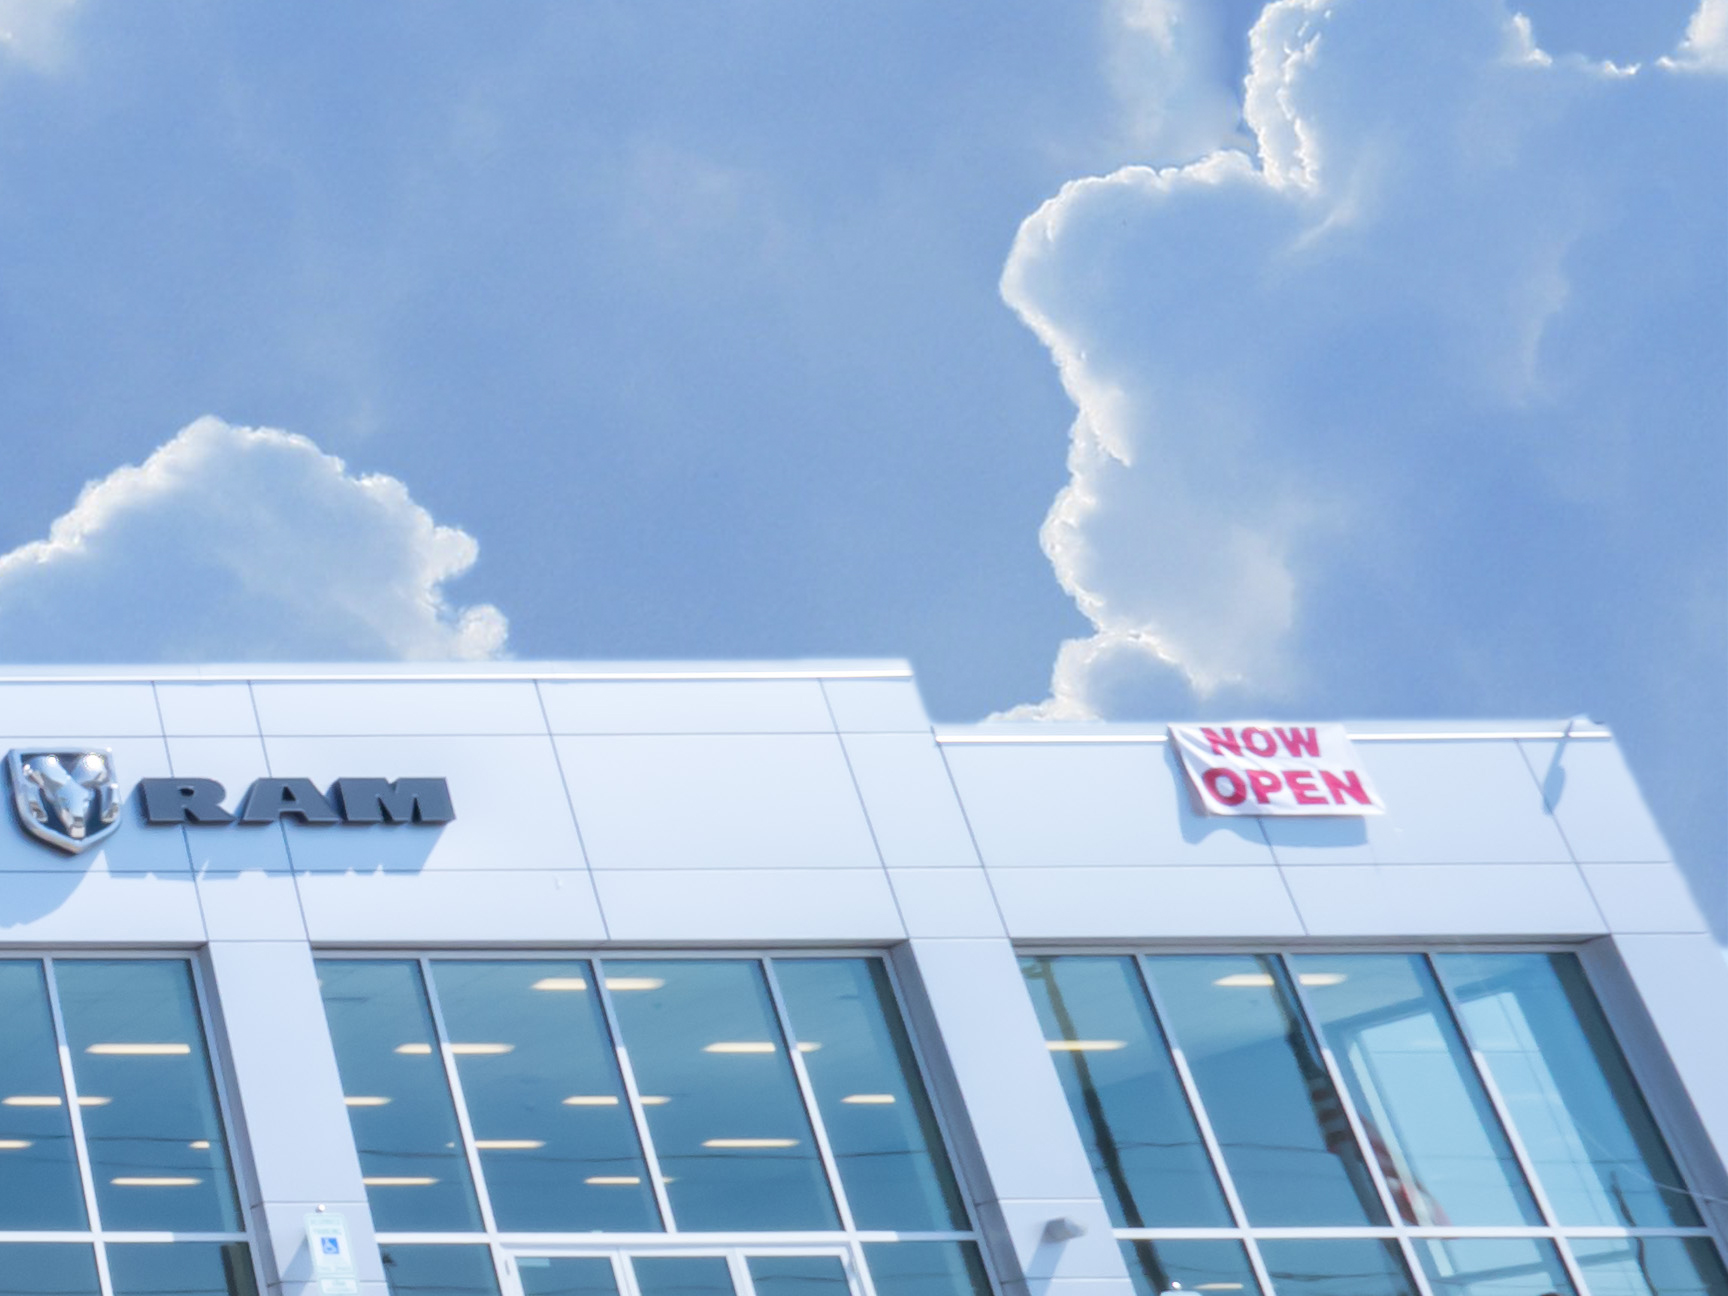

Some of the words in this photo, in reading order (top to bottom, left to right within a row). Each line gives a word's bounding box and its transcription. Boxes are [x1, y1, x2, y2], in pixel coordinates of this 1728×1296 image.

[1200, 726, 1321, 758] NOW
[139, 776, 457, 826] RAM
[1201, 767, 1373, 807] OPEN
